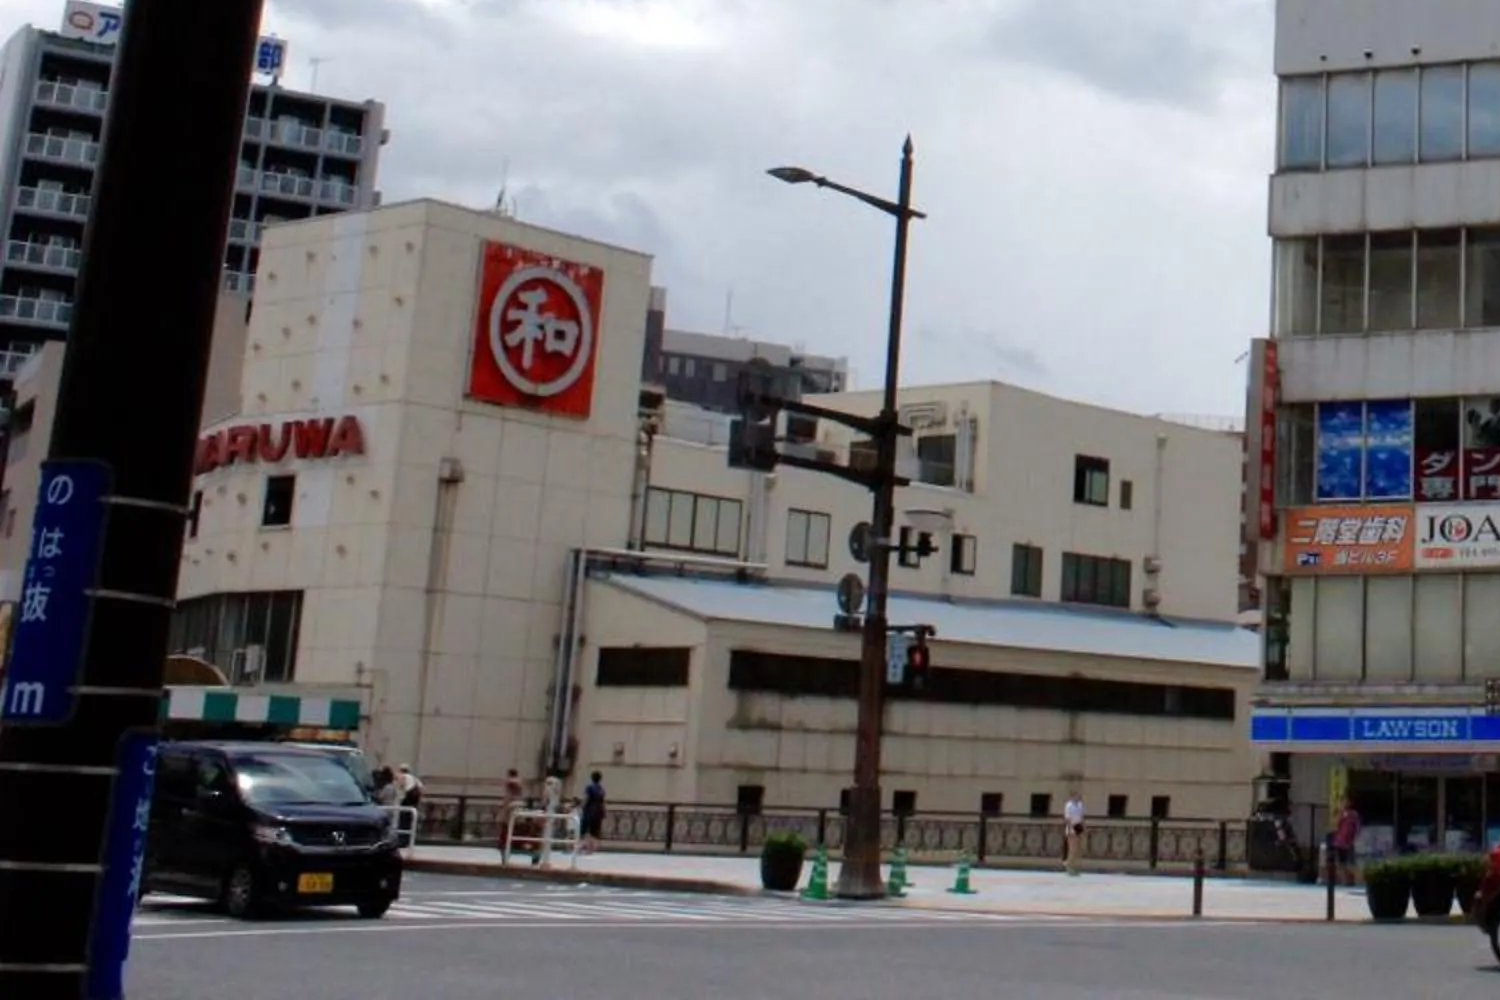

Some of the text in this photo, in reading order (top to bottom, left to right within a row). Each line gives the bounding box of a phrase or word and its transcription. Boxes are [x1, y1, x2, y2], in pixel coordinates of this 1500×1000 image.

[504, 286, 580, 370] 和
[195, 414, 366, 476] ARUWA
[47, 474, 74, 505] の
[10, 680, 45, 714] m
[1362, 719, 1459, 738] LAWSON
